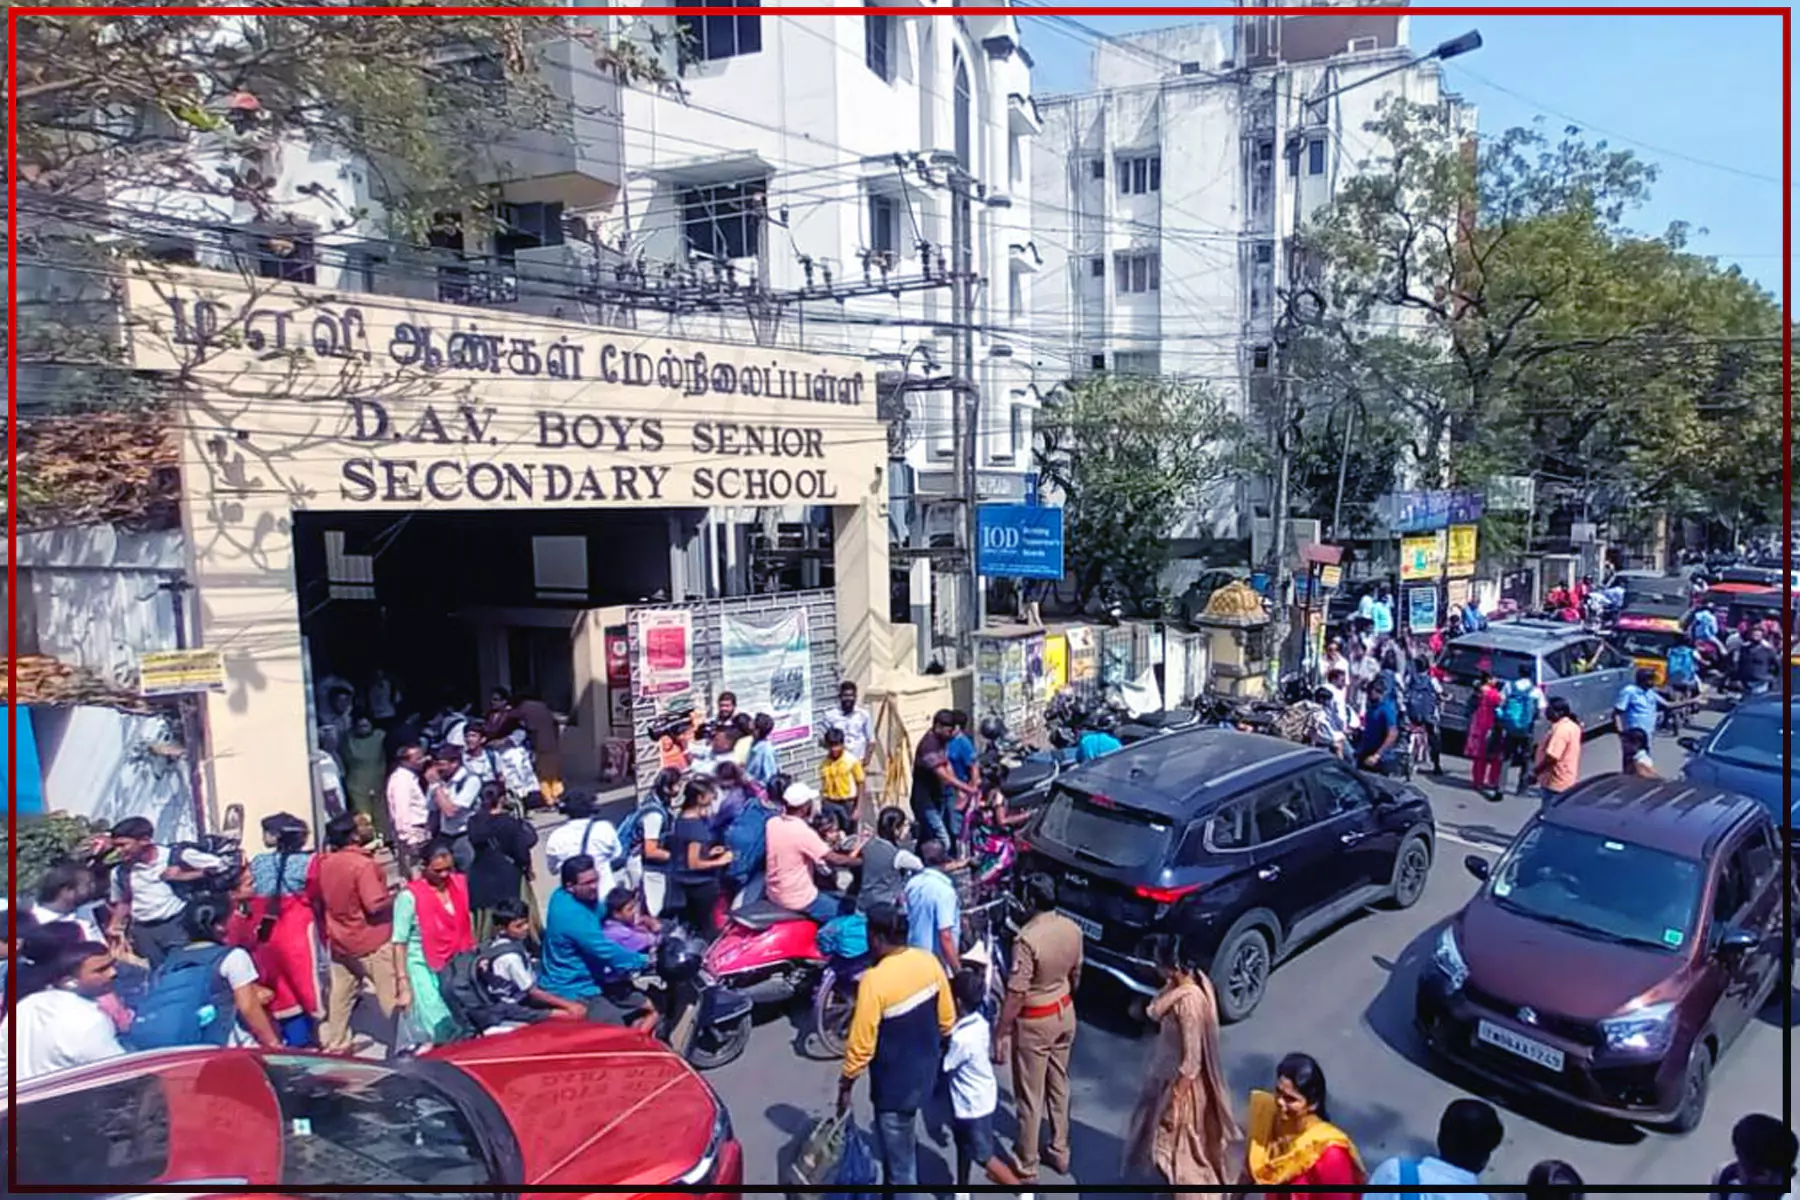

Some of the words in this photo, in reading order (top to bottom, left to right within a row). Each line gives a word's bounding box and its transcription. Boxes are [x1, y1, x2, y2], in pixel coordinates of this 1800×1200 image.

[389, 322, 584, 380] ஆண்கள்
[600, 343, 864, 405] மேல்நிலைப்பள்ளி
[347, 398, 498, 446] D.A.V.
[535, 410, 664, 452] BOYS
[692, 421, 825, 458] SENIOR
[340, 457, 671, 501] SECONDARY
[692, 467, 838, 500] SCHOOL
[983, 526, 1019, 548] IOD
